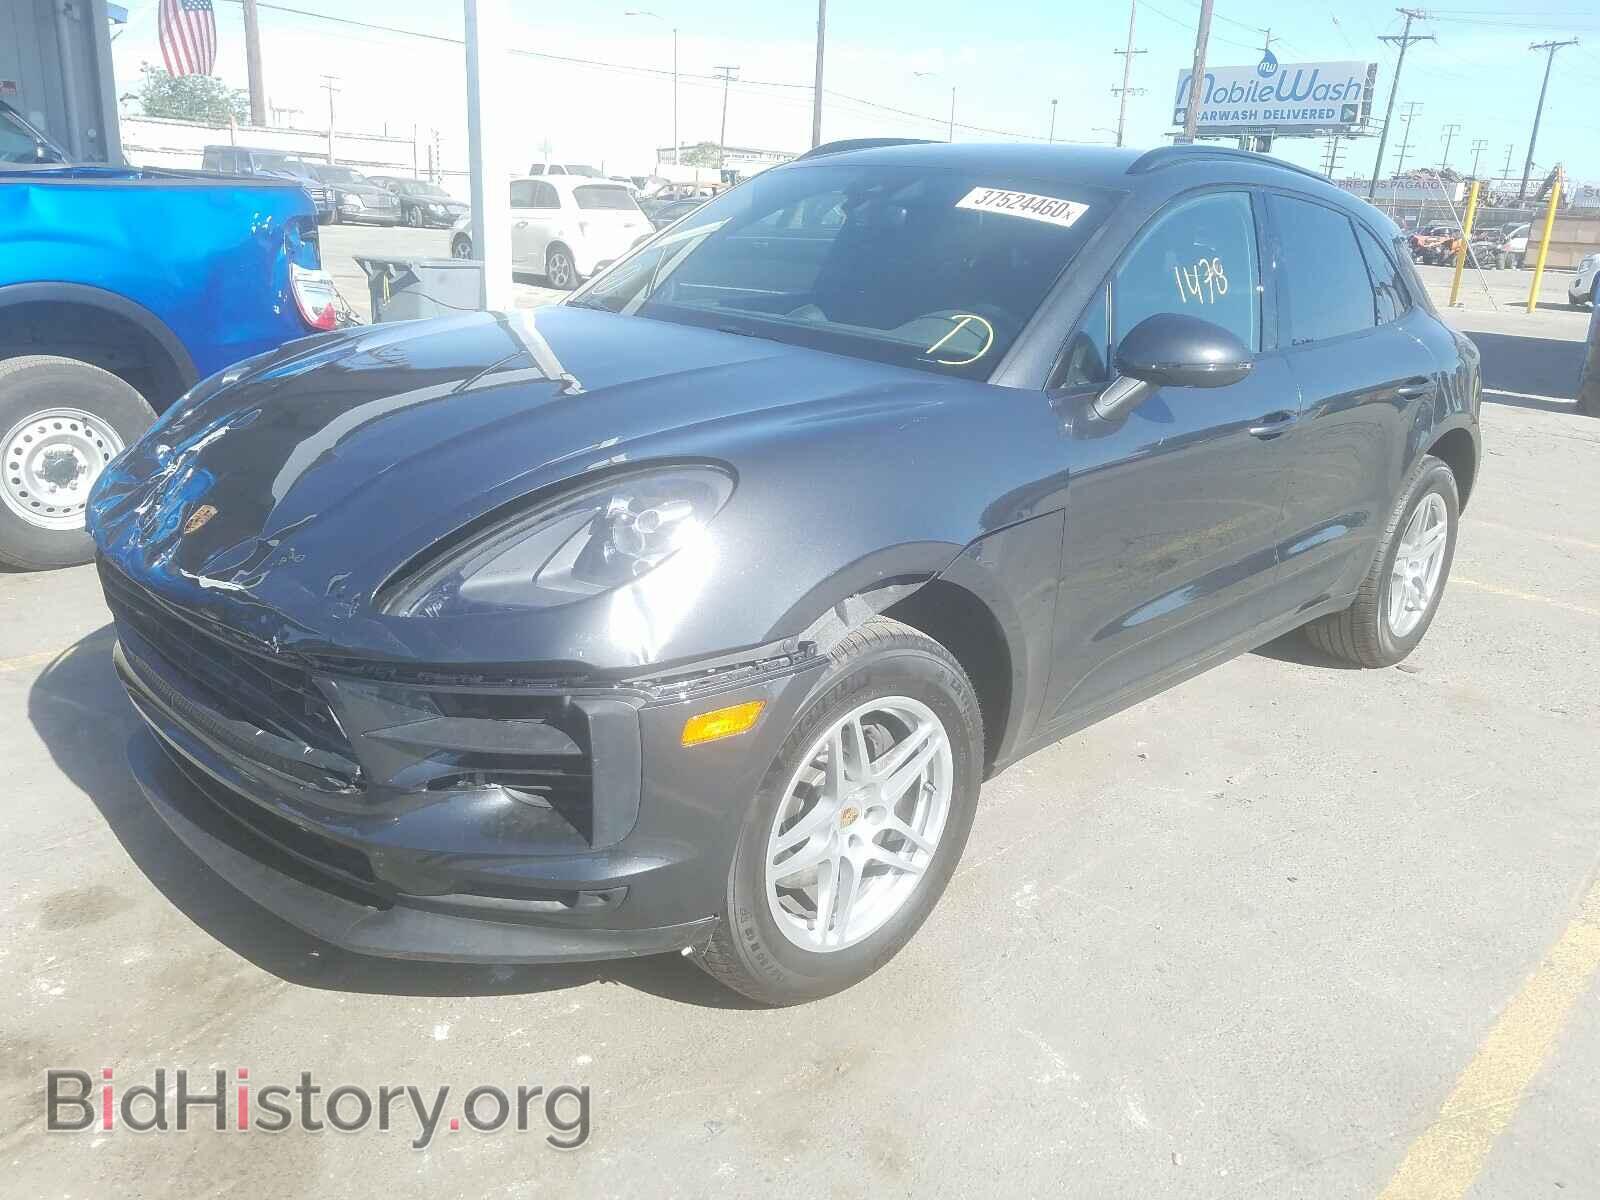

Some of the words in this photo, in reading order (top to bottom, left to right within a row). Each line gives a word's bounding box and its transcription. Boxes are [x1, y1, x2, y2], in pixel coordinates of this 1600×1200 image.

[1195, 108, 1258, 122] ARWASH
[1263, 107, 1336, 120] DELIVERED
[1175, 257, 1228, 304] 1478
